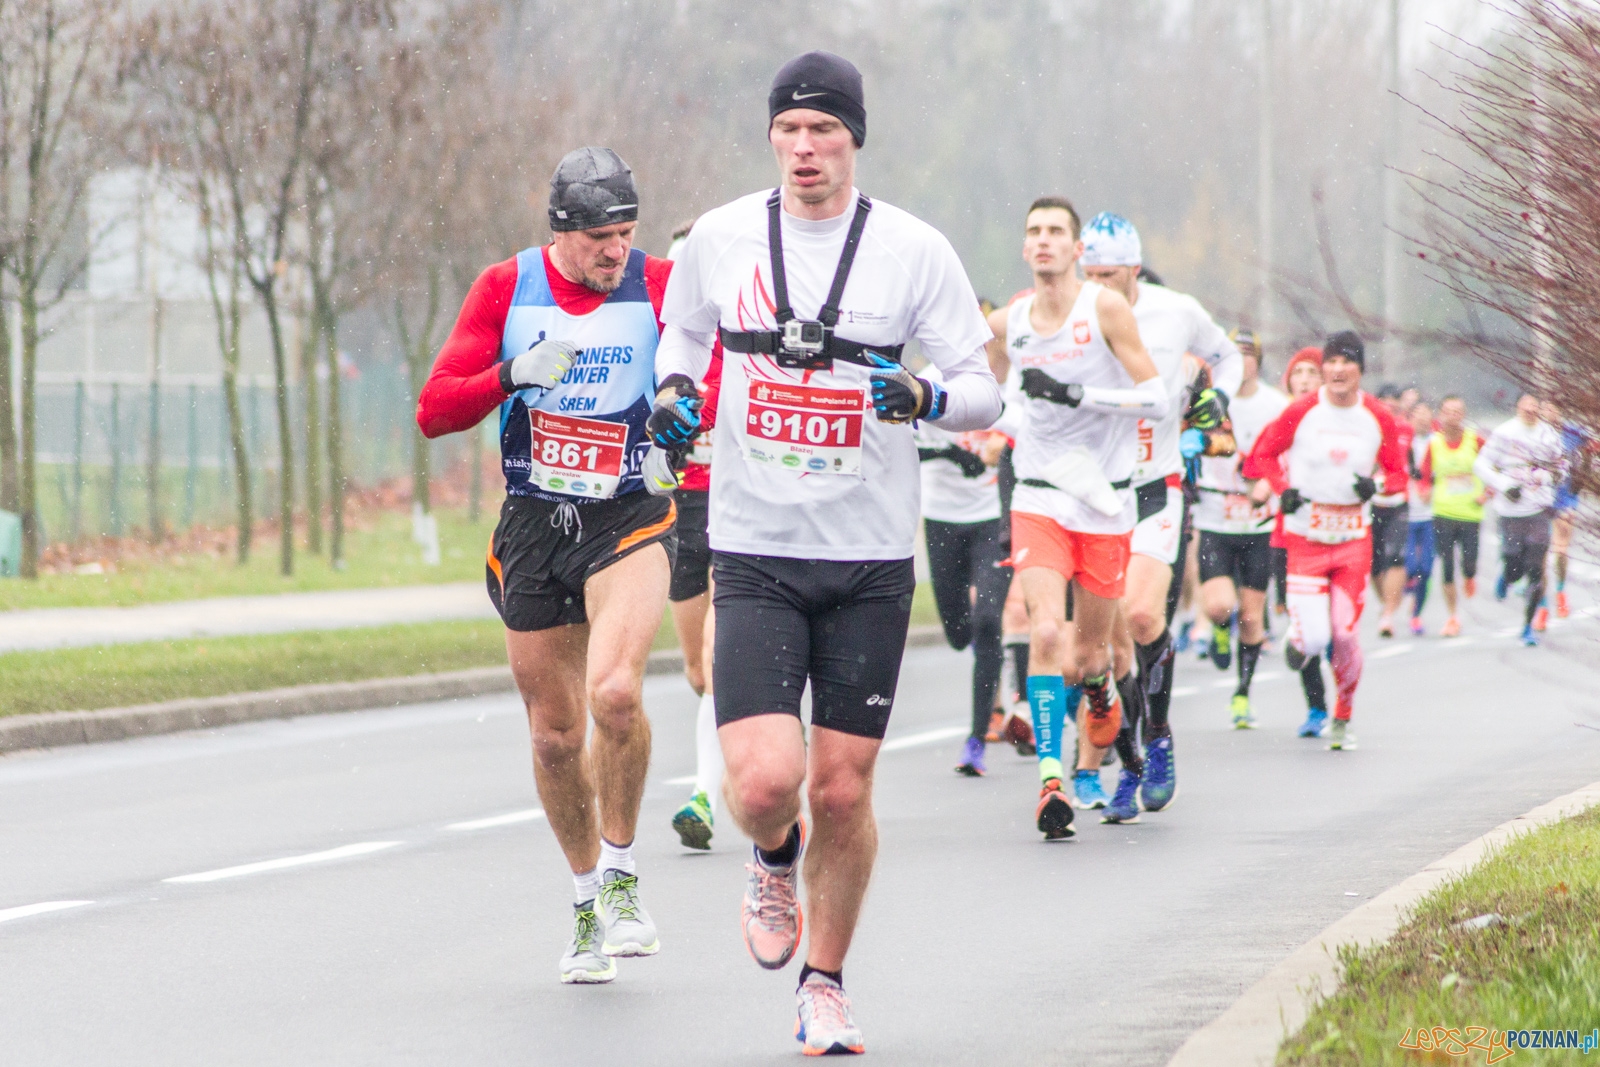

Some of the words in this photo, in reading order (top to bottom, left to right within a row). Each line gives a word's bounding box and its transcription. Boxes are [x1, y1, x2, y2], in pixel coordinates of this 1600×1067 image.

[576, 345, 633, 365] NNERS
[1020, 348, 1084, 367] POLSKA
[560, 366, 610, 384] OWER
[558, 394, 597, 411] ŚREM
[810, 395, 858, 406] RunPoland.org
[577, 426, 619, 439] RunPoland.org
[748, 414, 757, 425] B
[760, 410, 848, 444] 9101
[541, 440, 599, 470] 861
